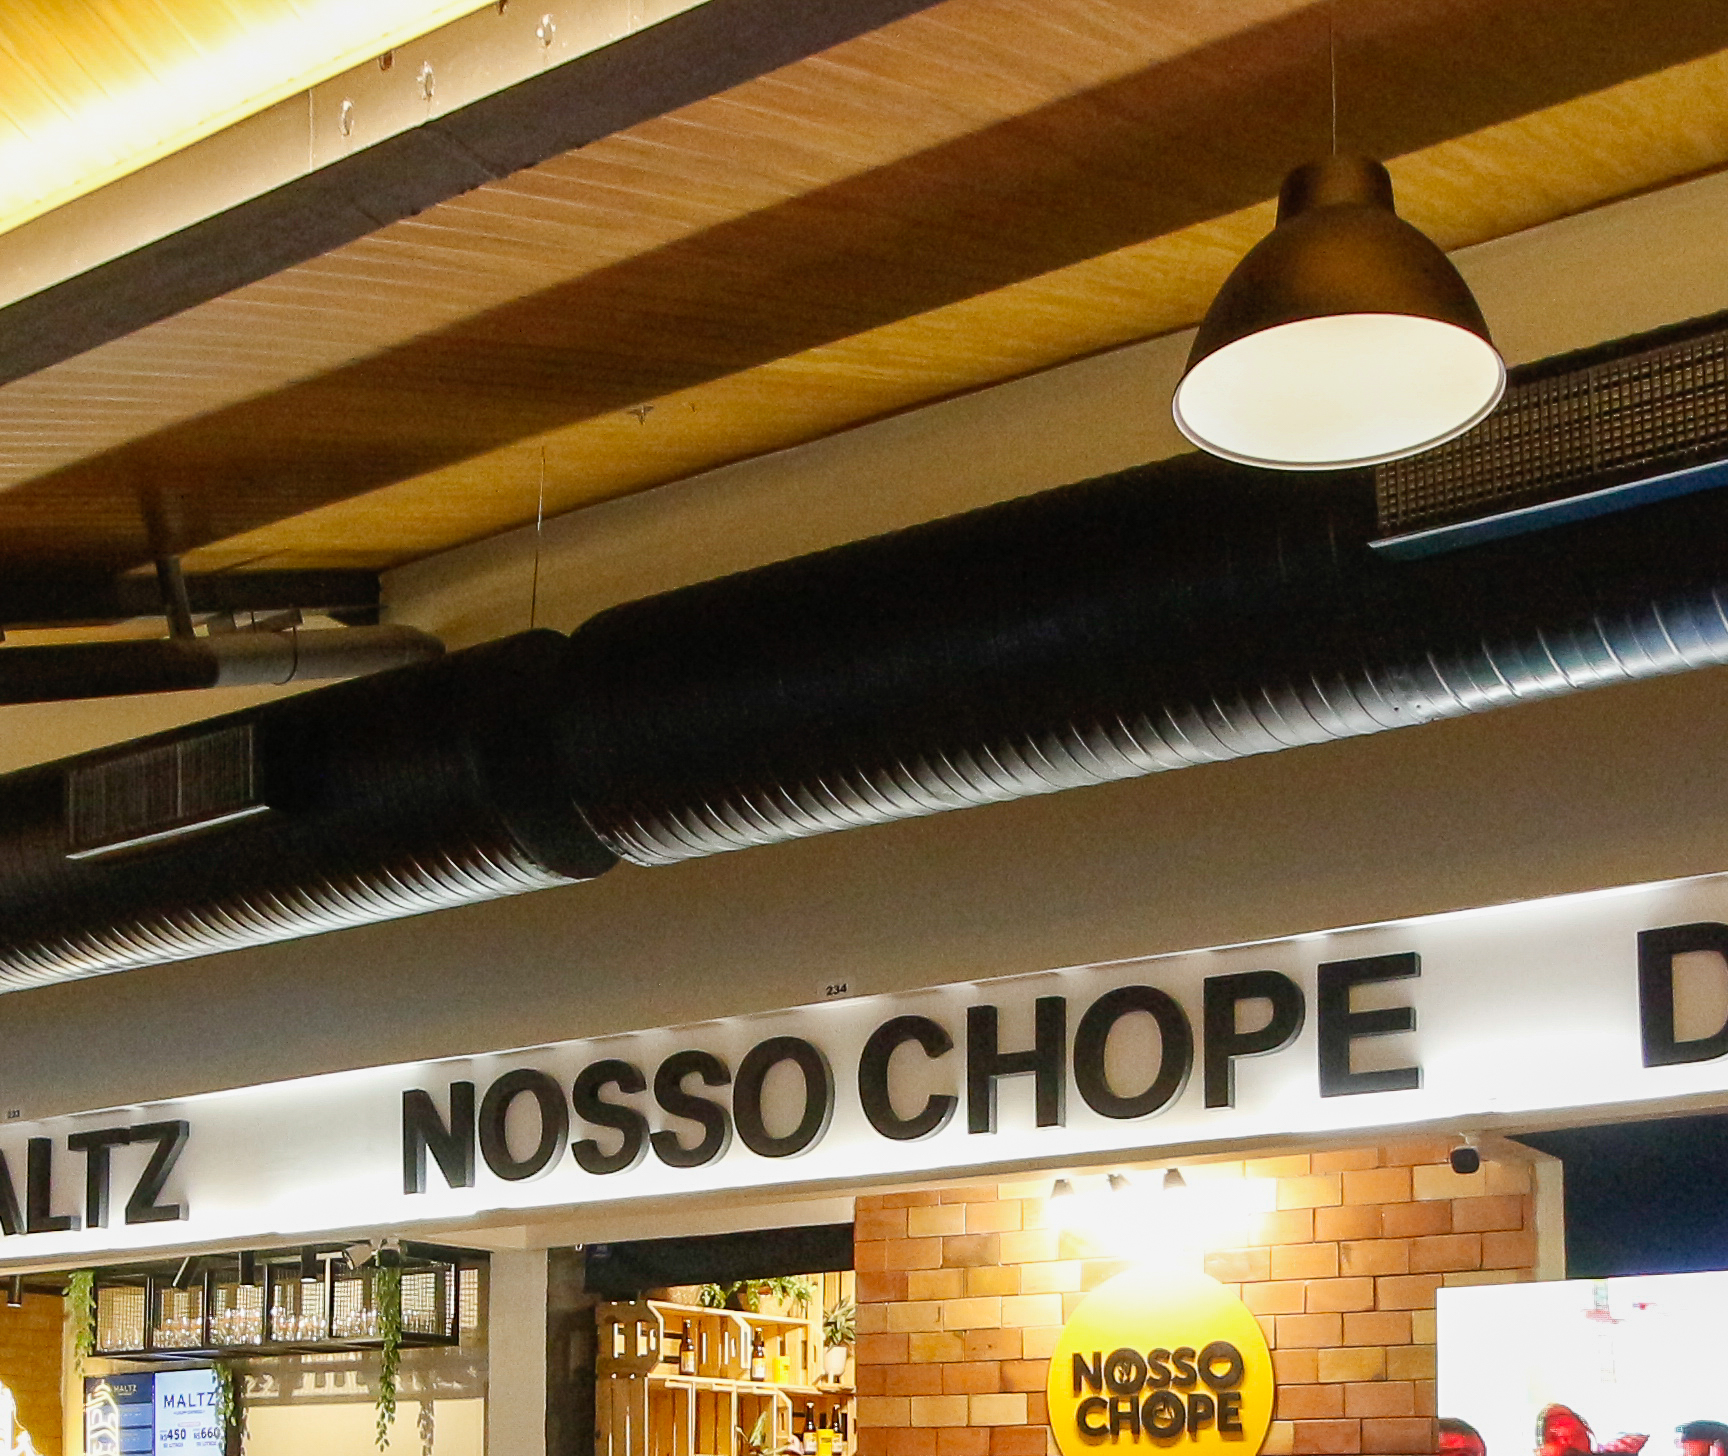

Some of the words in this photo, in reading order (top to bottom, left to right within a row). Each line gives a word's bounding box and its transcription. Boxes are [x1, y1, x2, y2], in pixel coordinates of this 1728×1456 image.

[825, 983, 847, 996] 234
[401, 1034, 835, 1197] NOSSO
[857, 951, 1424, 1144] CHOPE
[1071, 1340, 1245, 1397] NOSSO
[163, 1391, 216, 1409] MALTZ
[1076, 1390, 1245, 1442] CHOPE
